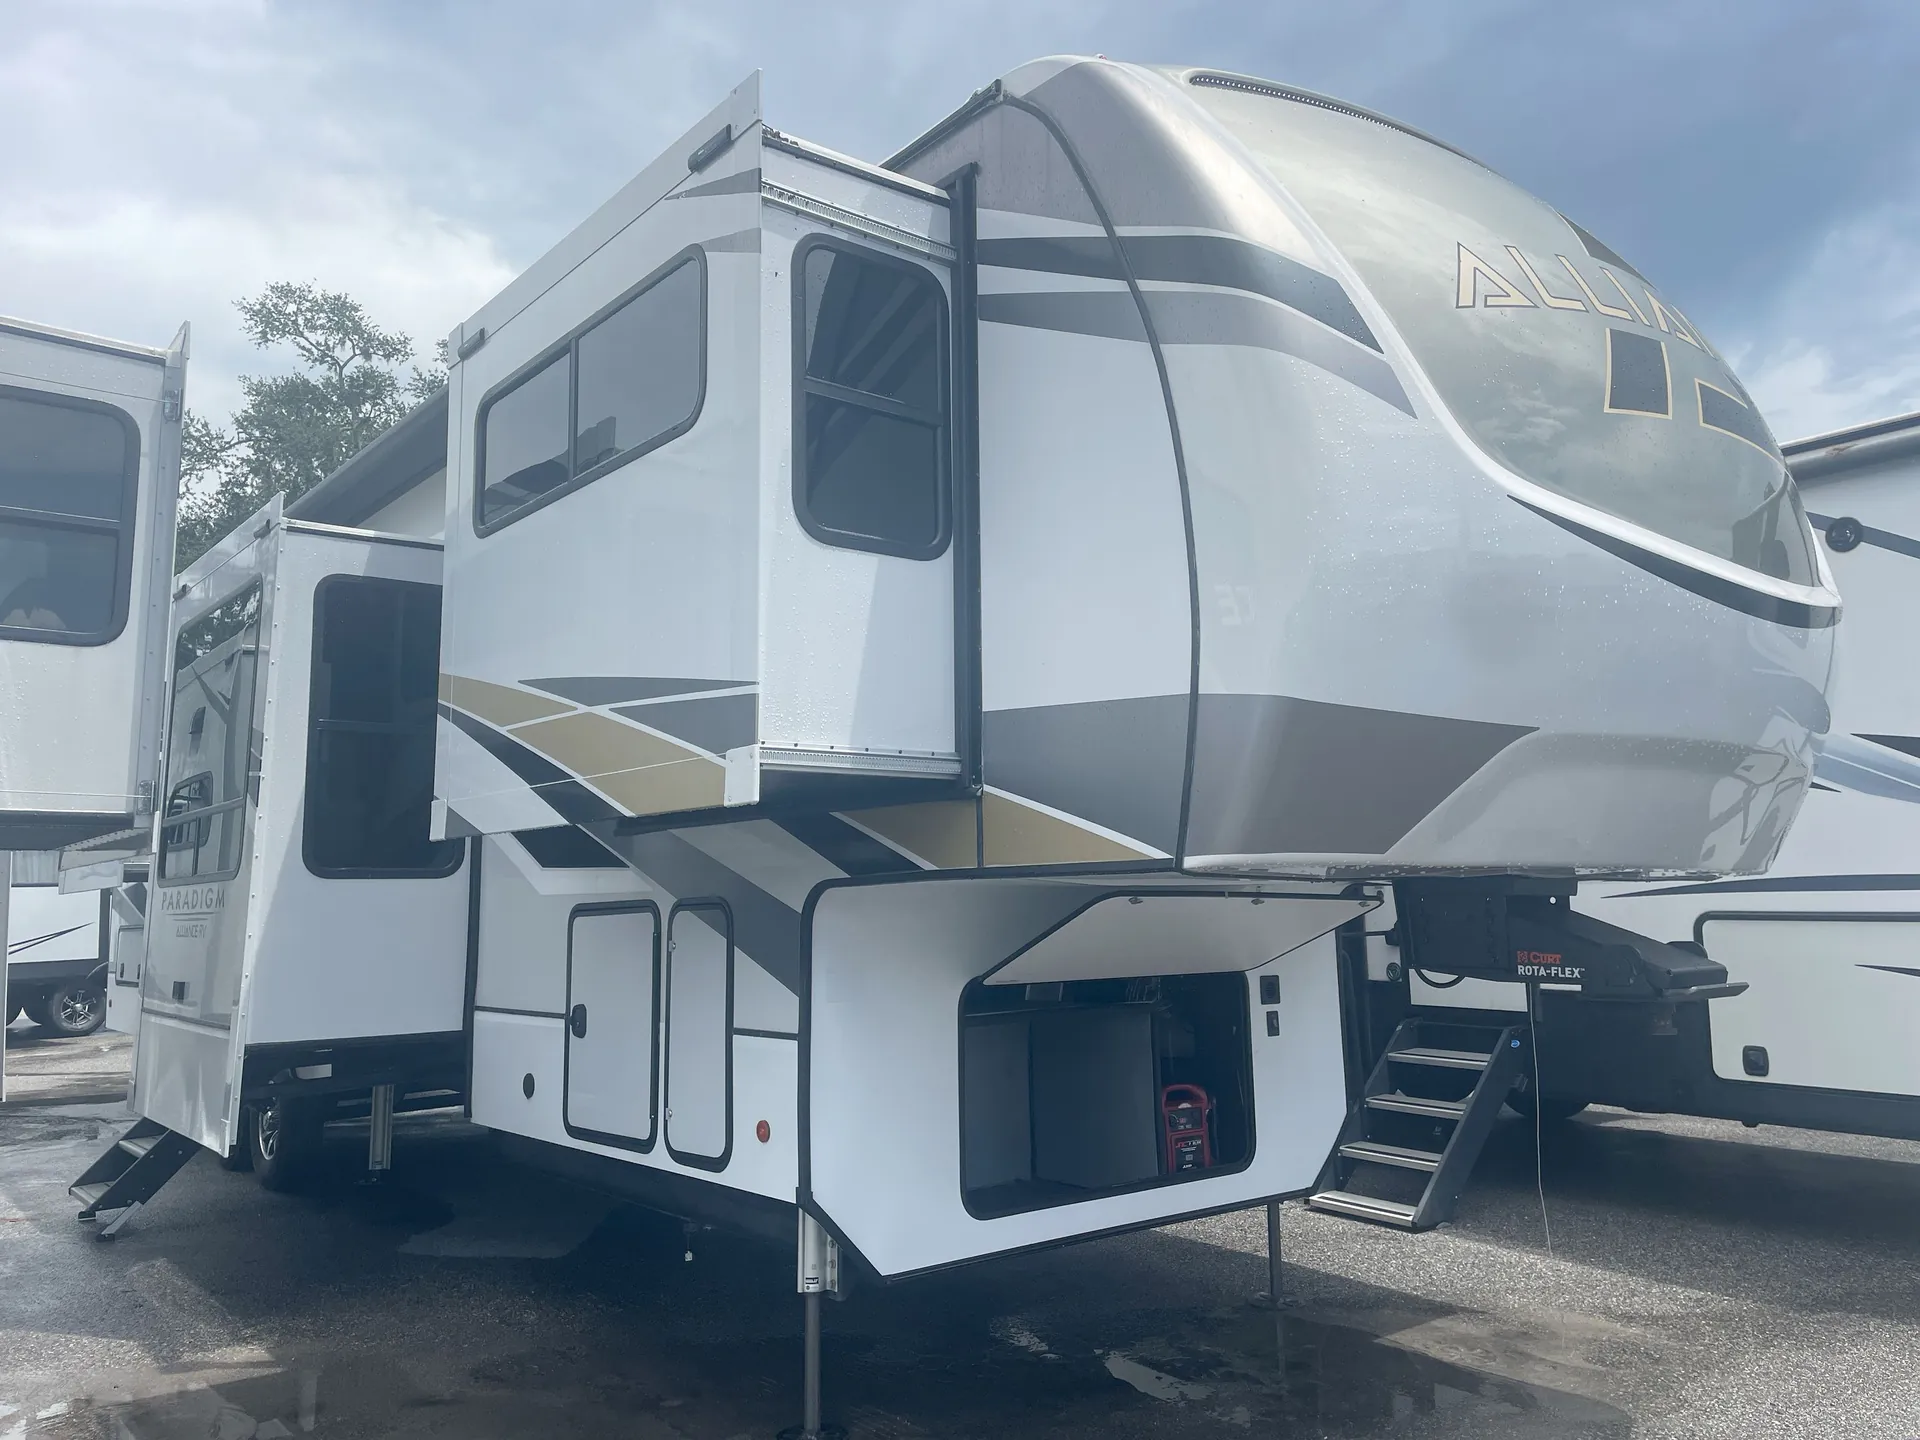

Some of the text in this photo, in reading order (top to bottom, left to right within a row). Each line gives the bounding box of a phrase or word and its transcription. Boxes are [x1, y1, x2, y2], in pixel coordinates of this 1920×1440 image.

[1456, 241, 1718, 361] ALLIA
[161, 887, 225, 911] PARADIGM
[1530, 951, 1562, 964] CURT
